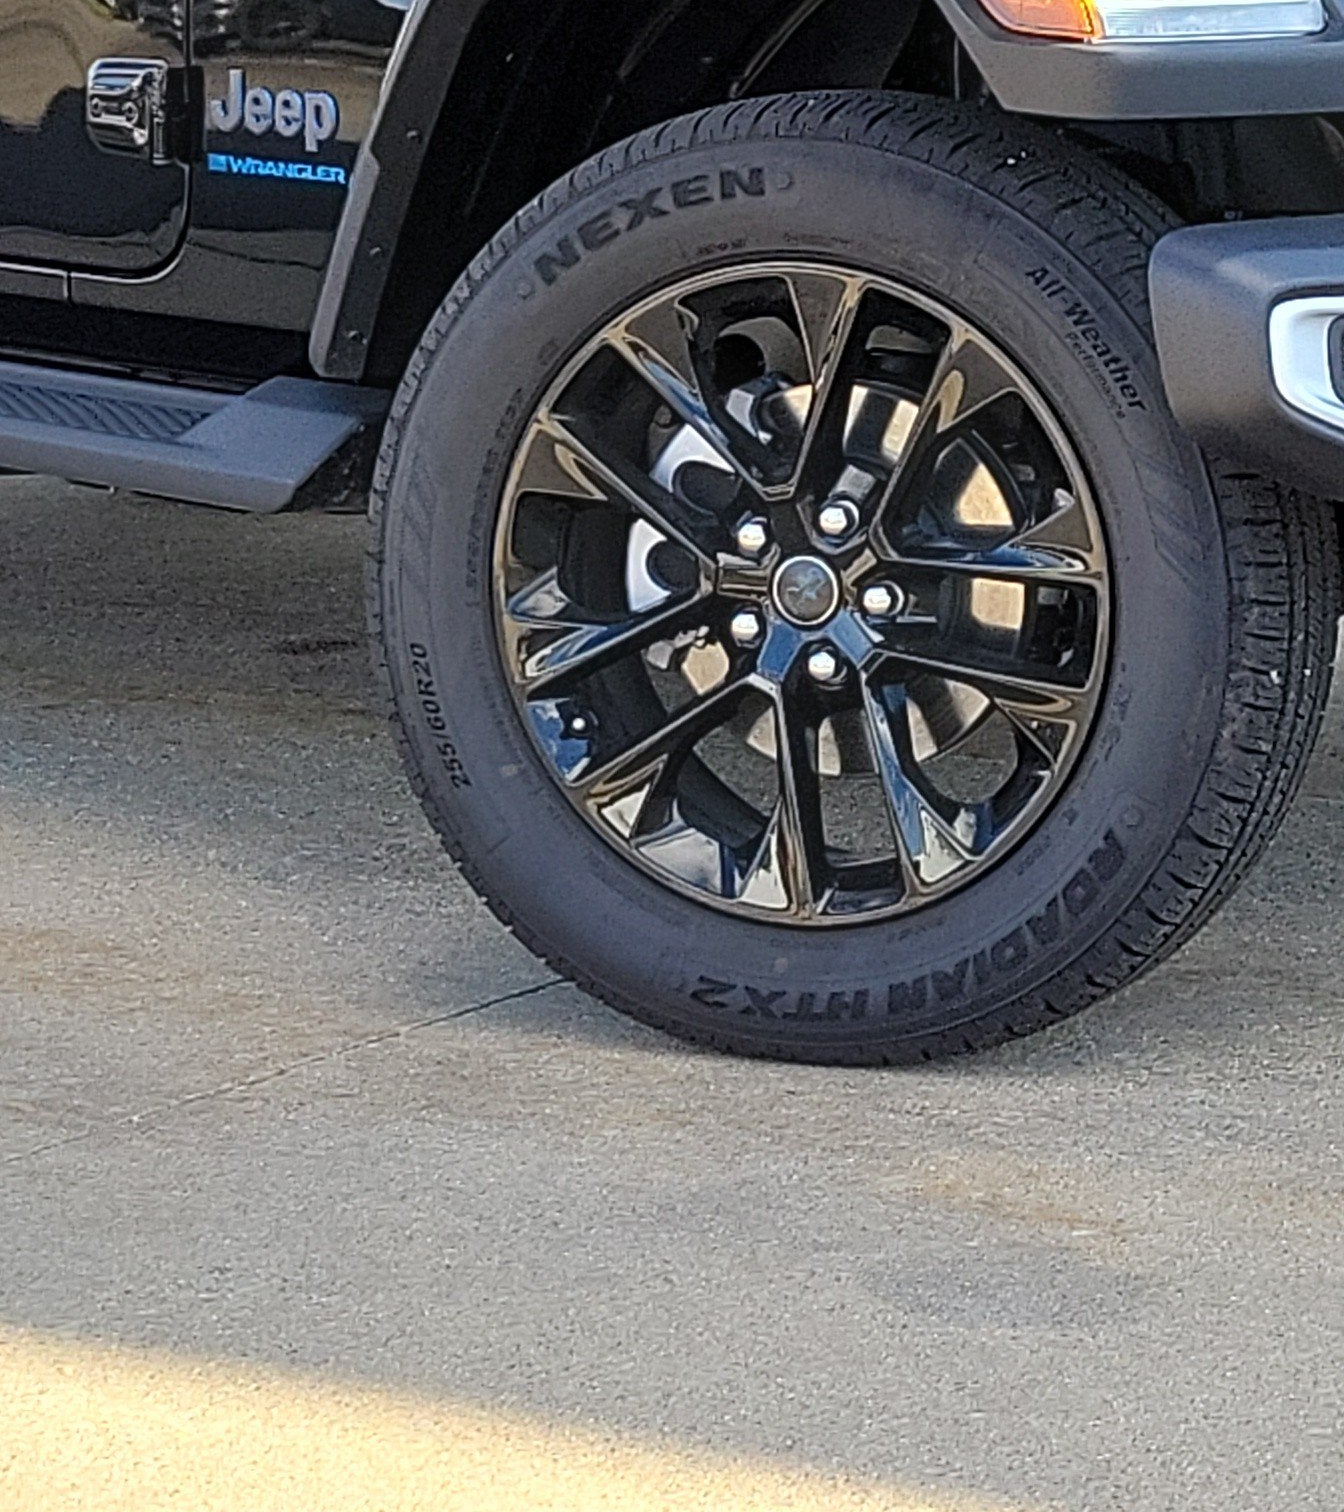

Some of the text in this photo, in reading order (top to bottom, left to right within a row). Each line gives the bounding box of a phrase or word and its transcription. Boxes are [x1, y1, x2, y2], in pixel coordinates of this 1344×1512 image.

[211, 67, 340, 153] Jeep
[228, 156, 347, 185] WRANGLER
[532, 166, 766, 287] NEXEN
[1025, 266, 1147, 411] All-Weather
[409, 641, 473, 789] 255/60R20
[690, 827, 1126, 1020] ROADIAN HTX2
